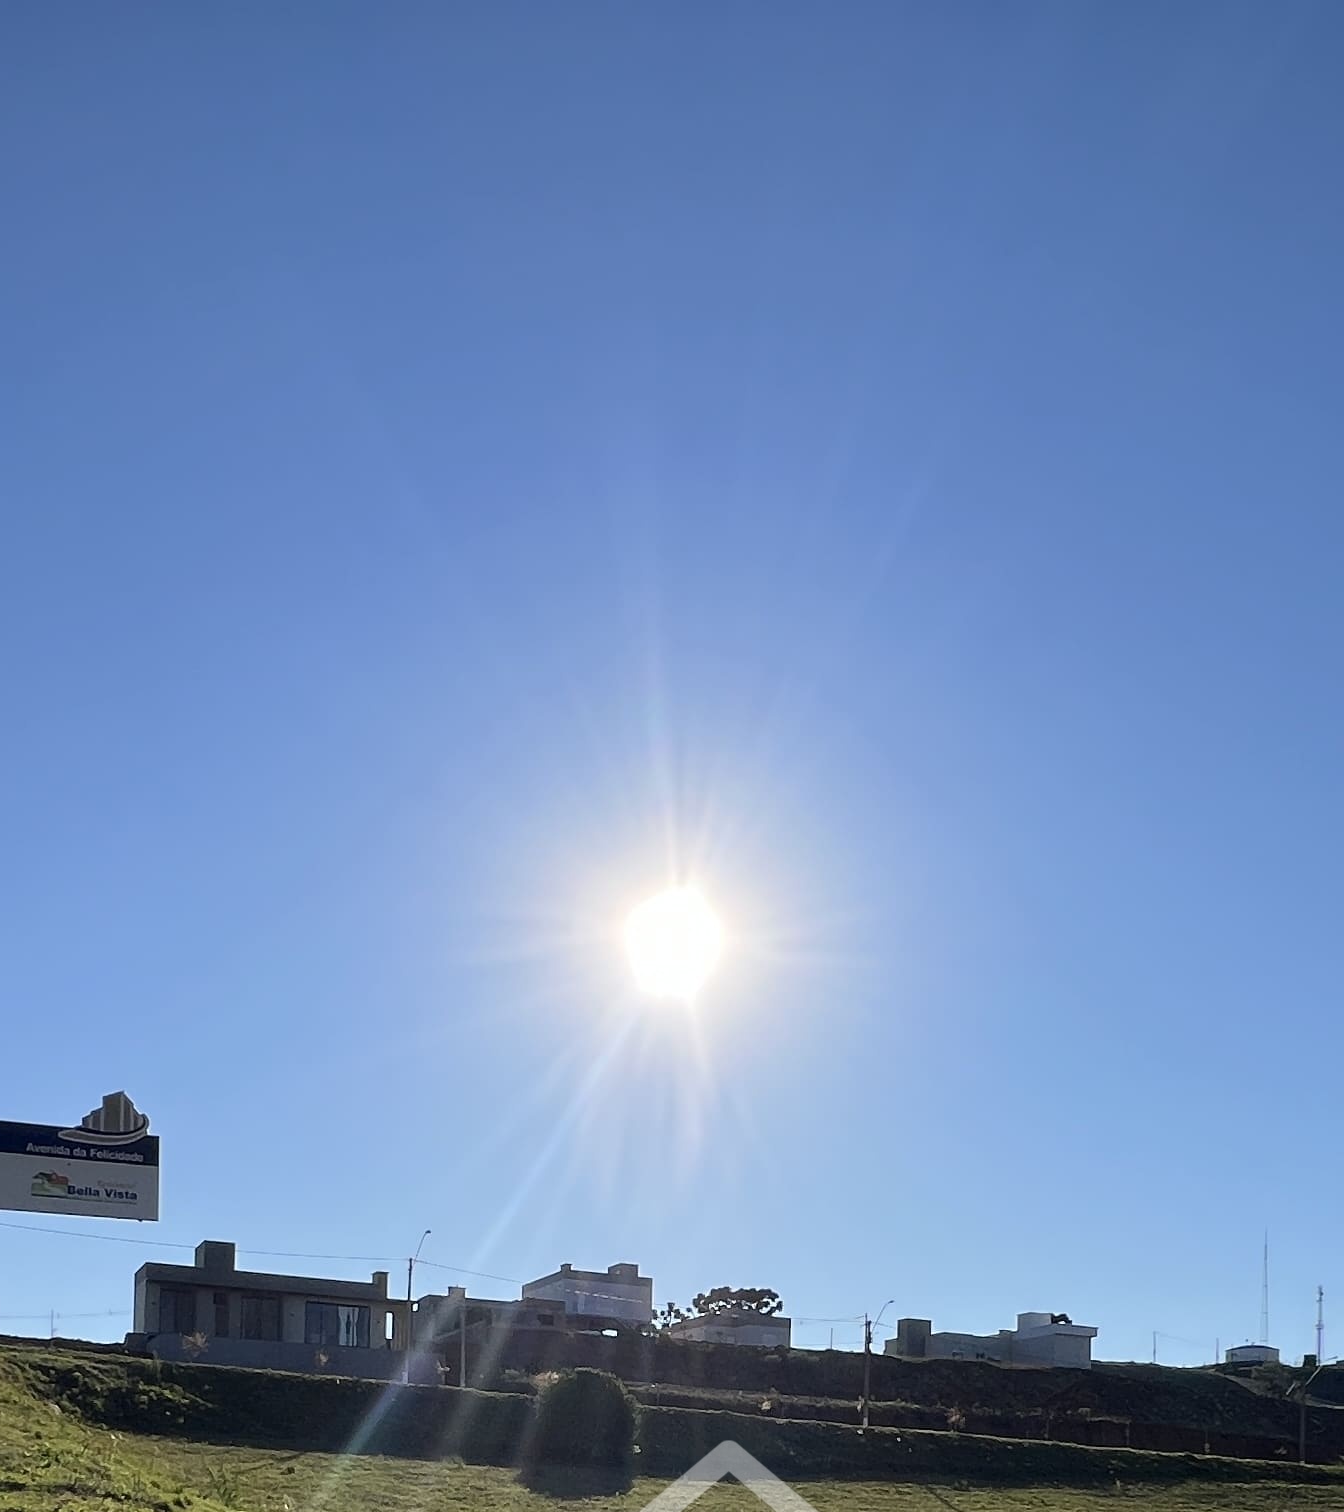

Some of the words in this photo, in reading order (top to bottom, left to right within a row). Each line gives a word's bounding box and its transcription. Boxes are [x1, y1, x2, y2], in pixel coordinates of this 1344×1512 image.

[26, 1142, 70, 1156] Avenida
[73, 1147, 87, 1157] da
[90, 1148, 144, 1163] Felicidade
[67, 1184, 100, 1198] Bella
[105, 1188, 138, 1201] Vista
